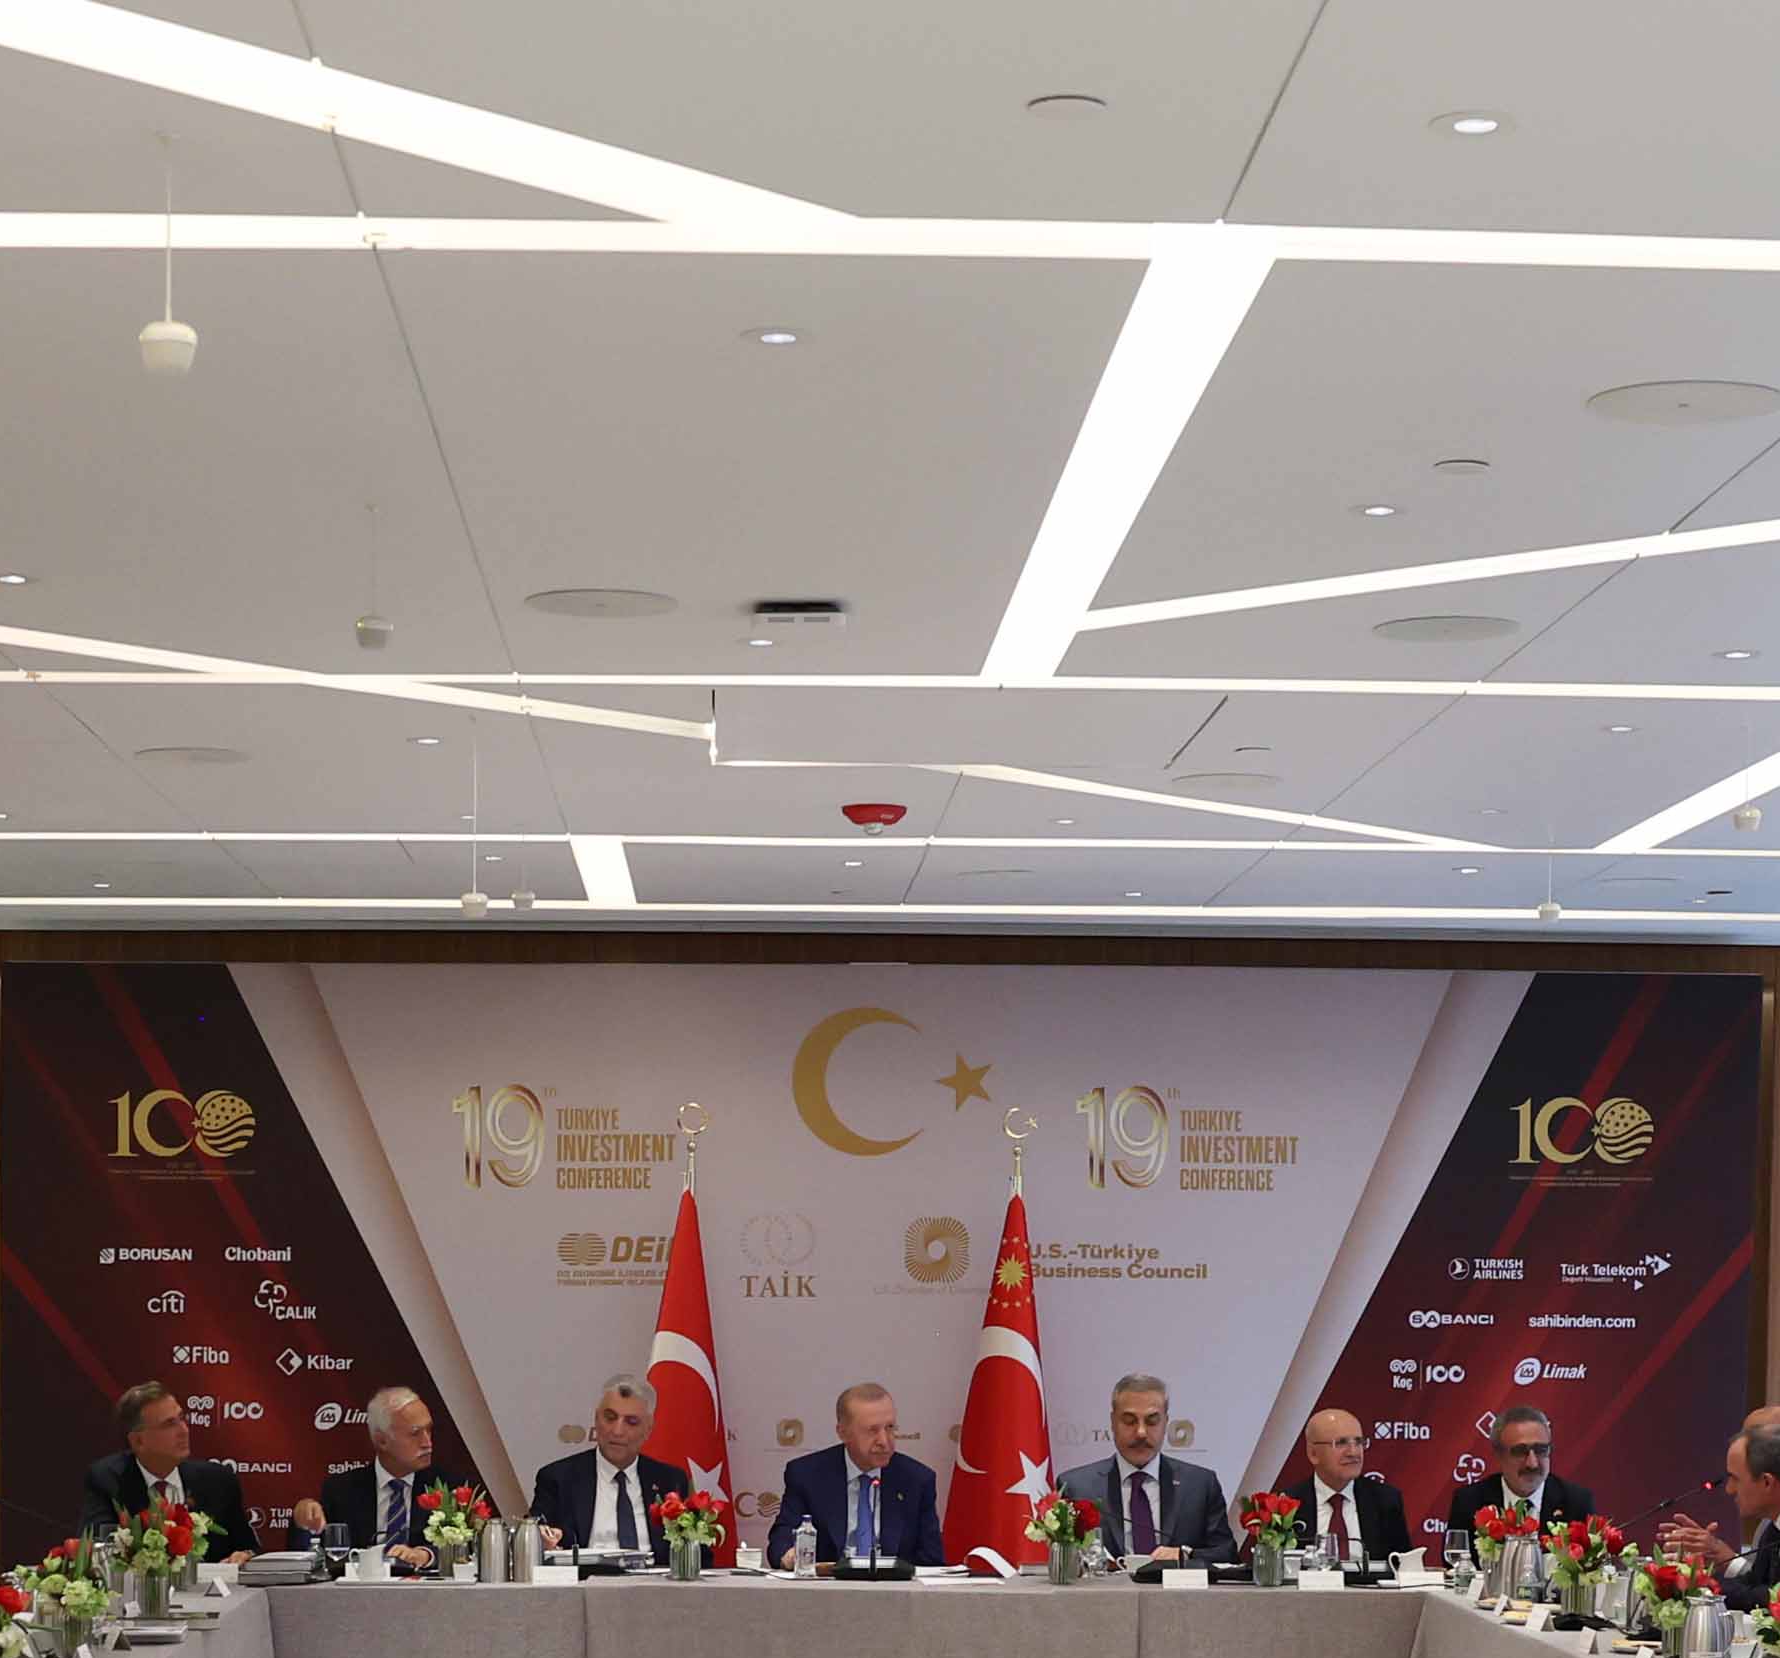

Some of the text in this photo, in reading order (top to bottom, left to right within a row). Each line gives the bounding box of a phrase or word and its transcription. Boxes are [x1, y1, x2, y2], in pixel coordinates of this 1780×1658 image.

[556, 1133, 677, 1162] INVESTMENT
[1180, 1136, 1299, 1164] INVESTMENT
[556, 1167, 652, 1190] CONFERENCE
[1180, 1168, 1274, 1190] CONFERENCE
[119, 1249, 192, 1261] BORUSAN
[225, 1246, 292, 1261] Chobani
[1032, 1263, 1208, 1279] Business Council
[1474, 1259, 1524, 1269] TURKISH
[1560, 1263, 1646, 1276] Türk Telekom
[1474, 1269, 1524, 1280] AIRLINES
[147, 1290, 185, 1313] citi
[1409, 1310, 1494, 1328] SABANCI
[1529, 1314, 1636, 1328] sahibinden.com
[192, 1346, 230, 1364] Fiba
[307, 1355, 354, 1370] Kibar
[1543, 1364, 1587, 1379] Limak
[1393, 1376, 1413, 1391] Koç
[190, 1411, 211, 1427] Koç
[344, 1408, 369, 1424] Lim
[1394, 1422, 1430, 1440] Fiba
